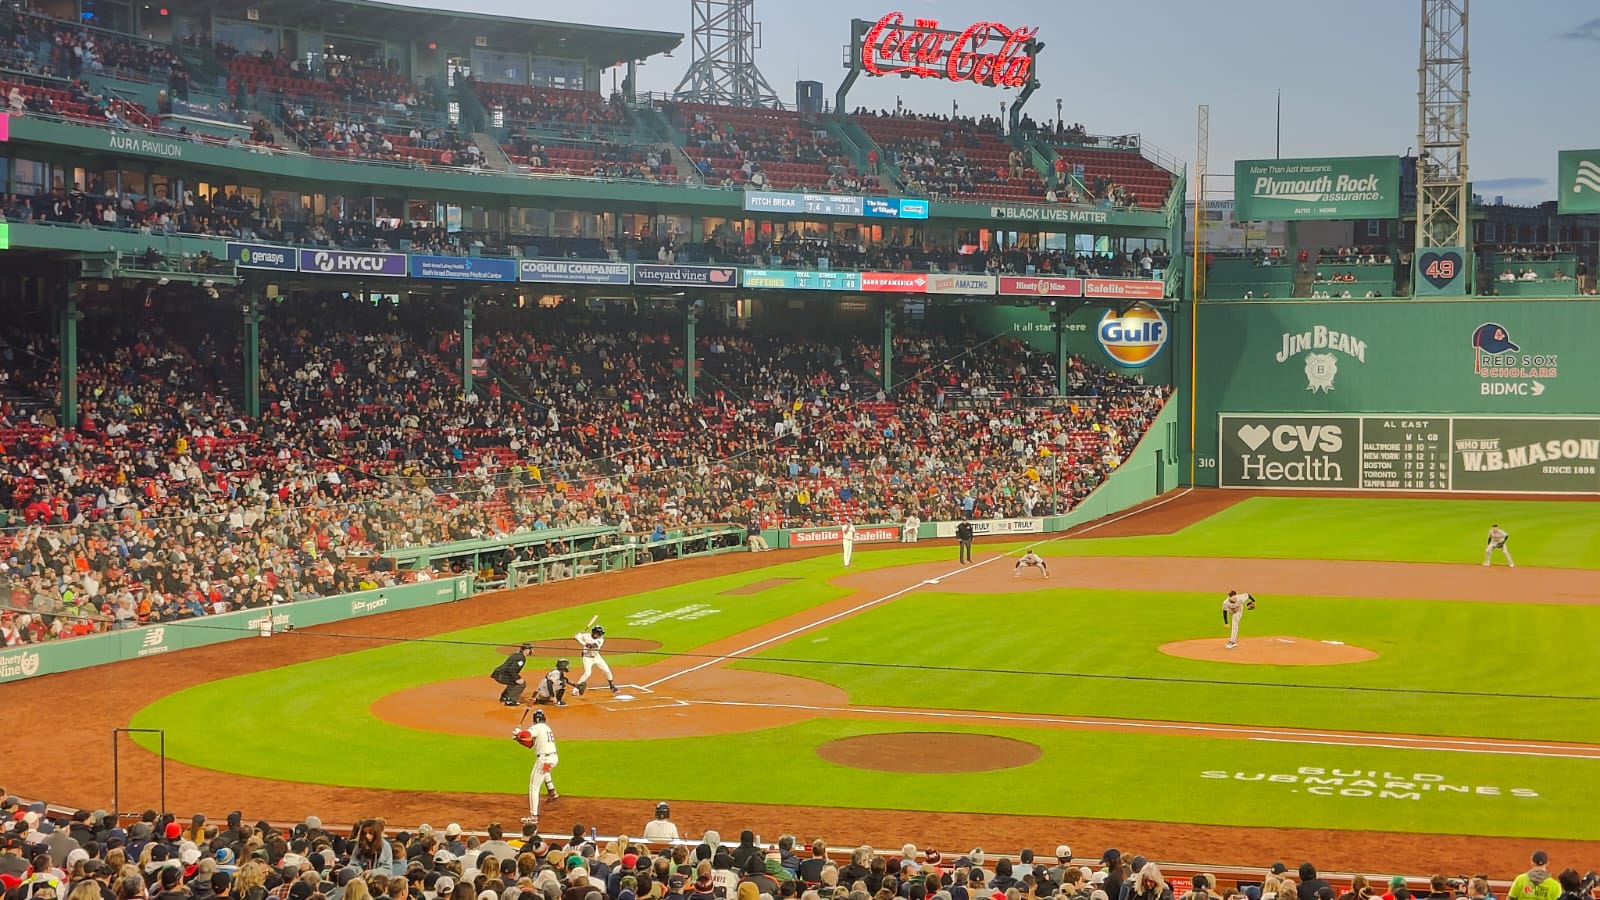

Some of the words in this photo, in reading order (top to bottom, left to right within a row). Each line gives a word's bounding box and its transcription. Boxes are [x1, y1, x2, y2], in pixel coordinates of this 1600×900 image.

[862, 11, 1039, 87] Coca-Cola
[142, 140, 182, 156] PAVILION
[1250, 166, 1268, 174] More
[1269, 166, 1285, 174] Than
[1285, 165, 1299, 174] Just
[1254, 175, 1333, 195] Plymouth
[1336, 174, 1379, 192] Rock
[752, 197, 772, 206] PITCH
[773, 198, 796, 207] BREAK
[1006, 207, 1039, 219] BLACK
[1041, 209, 1068, 220] LIVES
[1070, 211, 1107, 222] MATTER
[252, 250, 284, 265] genasys
[337, 255, 384, 271] HYCU
[521, 262, 567, 273] COGHLIN
[568, 264, 628, 275] COMPANIES
[1425, 260, 1454, 278] 49
[638, 270, 680, 281] vineyard
[681, 271, 707, 281] vines
[955, 279, 988, 289] AMAZING
[1087, 283, 1124, 294] Safelite
[1013, 323, 1021, 331] It
[1022, 323, 1033, 331] all
[1101, 322, 1162, 342] Gulf
[1275, 332, 1312, 363] JIM
[1313, 325, 1365, 363] BEAM
[1481, 355, 1516, 367] RED
[1522, 354, 1558, 367] SOX
[1480, 367, 1557, 378] SCHOLARS
[1480, 382, 1528, 395] BIDMC
[1272, 424, 1343, 452] CVS
[1363, 443, 1401, 451] BALTIMORE
[1404, 443, 1412, 451] 19
[1416, 443, 1424, 451] 10
[1455, 440, 1478, 450] WHO
[1479, 440, 1499, 450] BUT
[1363, 452, 1379, 460] NEW
[1381, 452, 1400, 460] YORK
[1198, 458, 1215, 468] 310
[1241, 454, 1343, 481] Health
[1429, 462, 1435, 470] 2
[1542, 466, 1572, 474] SINCE
[1364, 480, 1385, 488] TAMPA
[1014, 521, 1032, 529] TRULY
[797, 532, 839, 541] Safelite
[854, 530, 892, 541] Safelite
[366, 598, 388, 611] TICKET
[1298, 766, 1444, 782] BUILD
[1200, 770, 1539, 798] SUBMARINES
